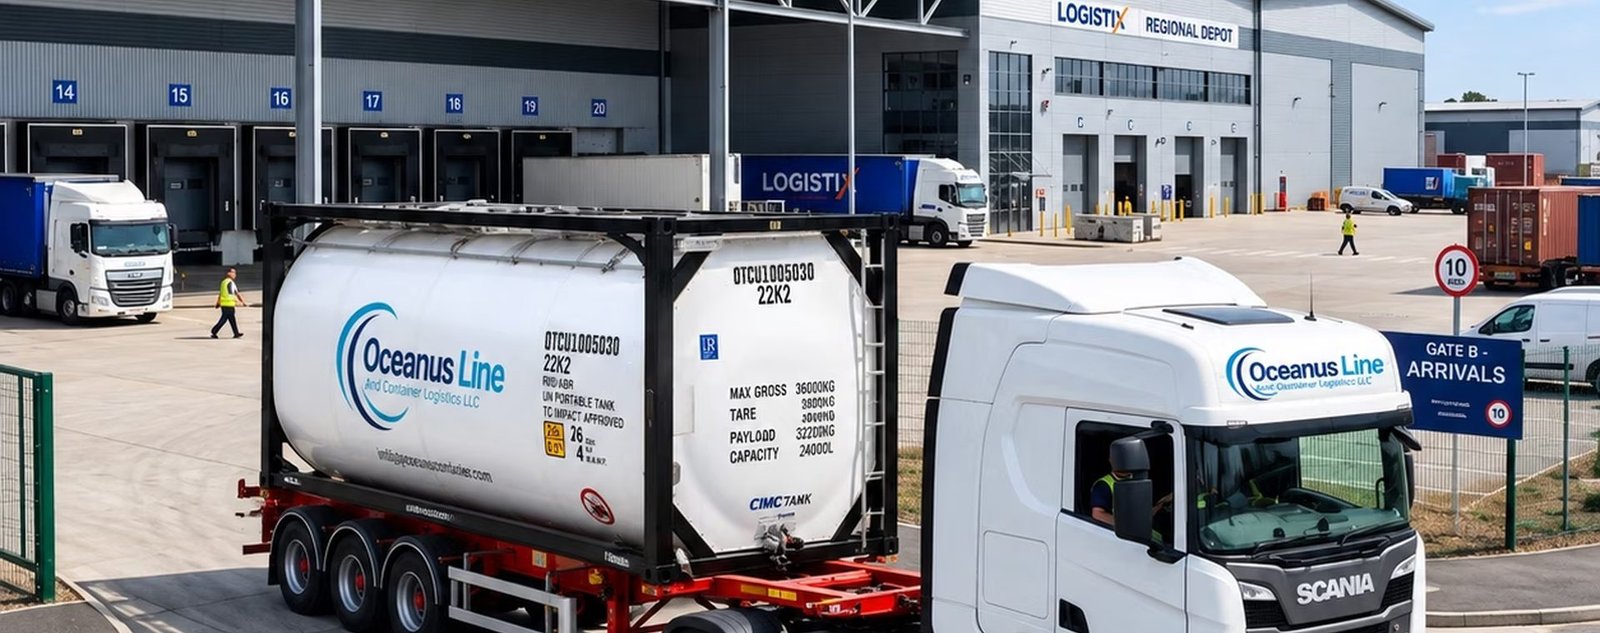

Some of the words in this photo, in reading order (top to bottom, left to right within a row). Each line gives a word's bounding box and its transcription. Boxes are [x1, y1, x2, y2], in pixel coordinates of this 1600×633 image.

[1057, 1, 1129, 33] LOGISTIX
[1146, 16, 1199, 39] REGIONAL
[1201, 25, 1233, 43] DEPOT
[55, 84, 75, 100] 14
[171, 87, 188, 103] 15
[273, 91, 289, 106] 16
[365, 94, 380, 108] 17
[524, 100, 536, 113] 19
[593, 102, 605, 115] 20
[762, 167, 859, 200] LOGISTIX
[1445, 258, 1467, 277] 10
[757, 284, 792, 305] 22K2
[1426, 342, 1464, 357] GATE
[1468, 345, 1478, 358] B
[363, 337, 454, 384] Oceanus
[458, 350, 505, 393] Line
[543, 353, 571, 374] 22K2
[1249, 361, 1338, 382] Oceanus
[1341, 354, 1384, 376] Line
[1406, 361, 1506, 384] ARRIVALS
[364, 378, 380, 391] And
[383, 381, 421, 398] Container
[423, 389, 461, 405] Logistics
[463, 395, 479, 408] LLC
[730, 386, 751, 400] MAX
[754, 383, 787, 398] GROSS
[795, 380, 835, 395] 36000KG
[729, 407, 756, 421] TARE
[1491, 408, 1505, 420] 10
[576, 445, 584, 462] 4
[730, 447, 779, 464] CAPACITY
[799, 442, 834, 457] 24000L
[749, 496, 783, 510] CIMC
[783, 493, 812, 507] TANK
[1296, 572, 1375, 605] SCANIA
